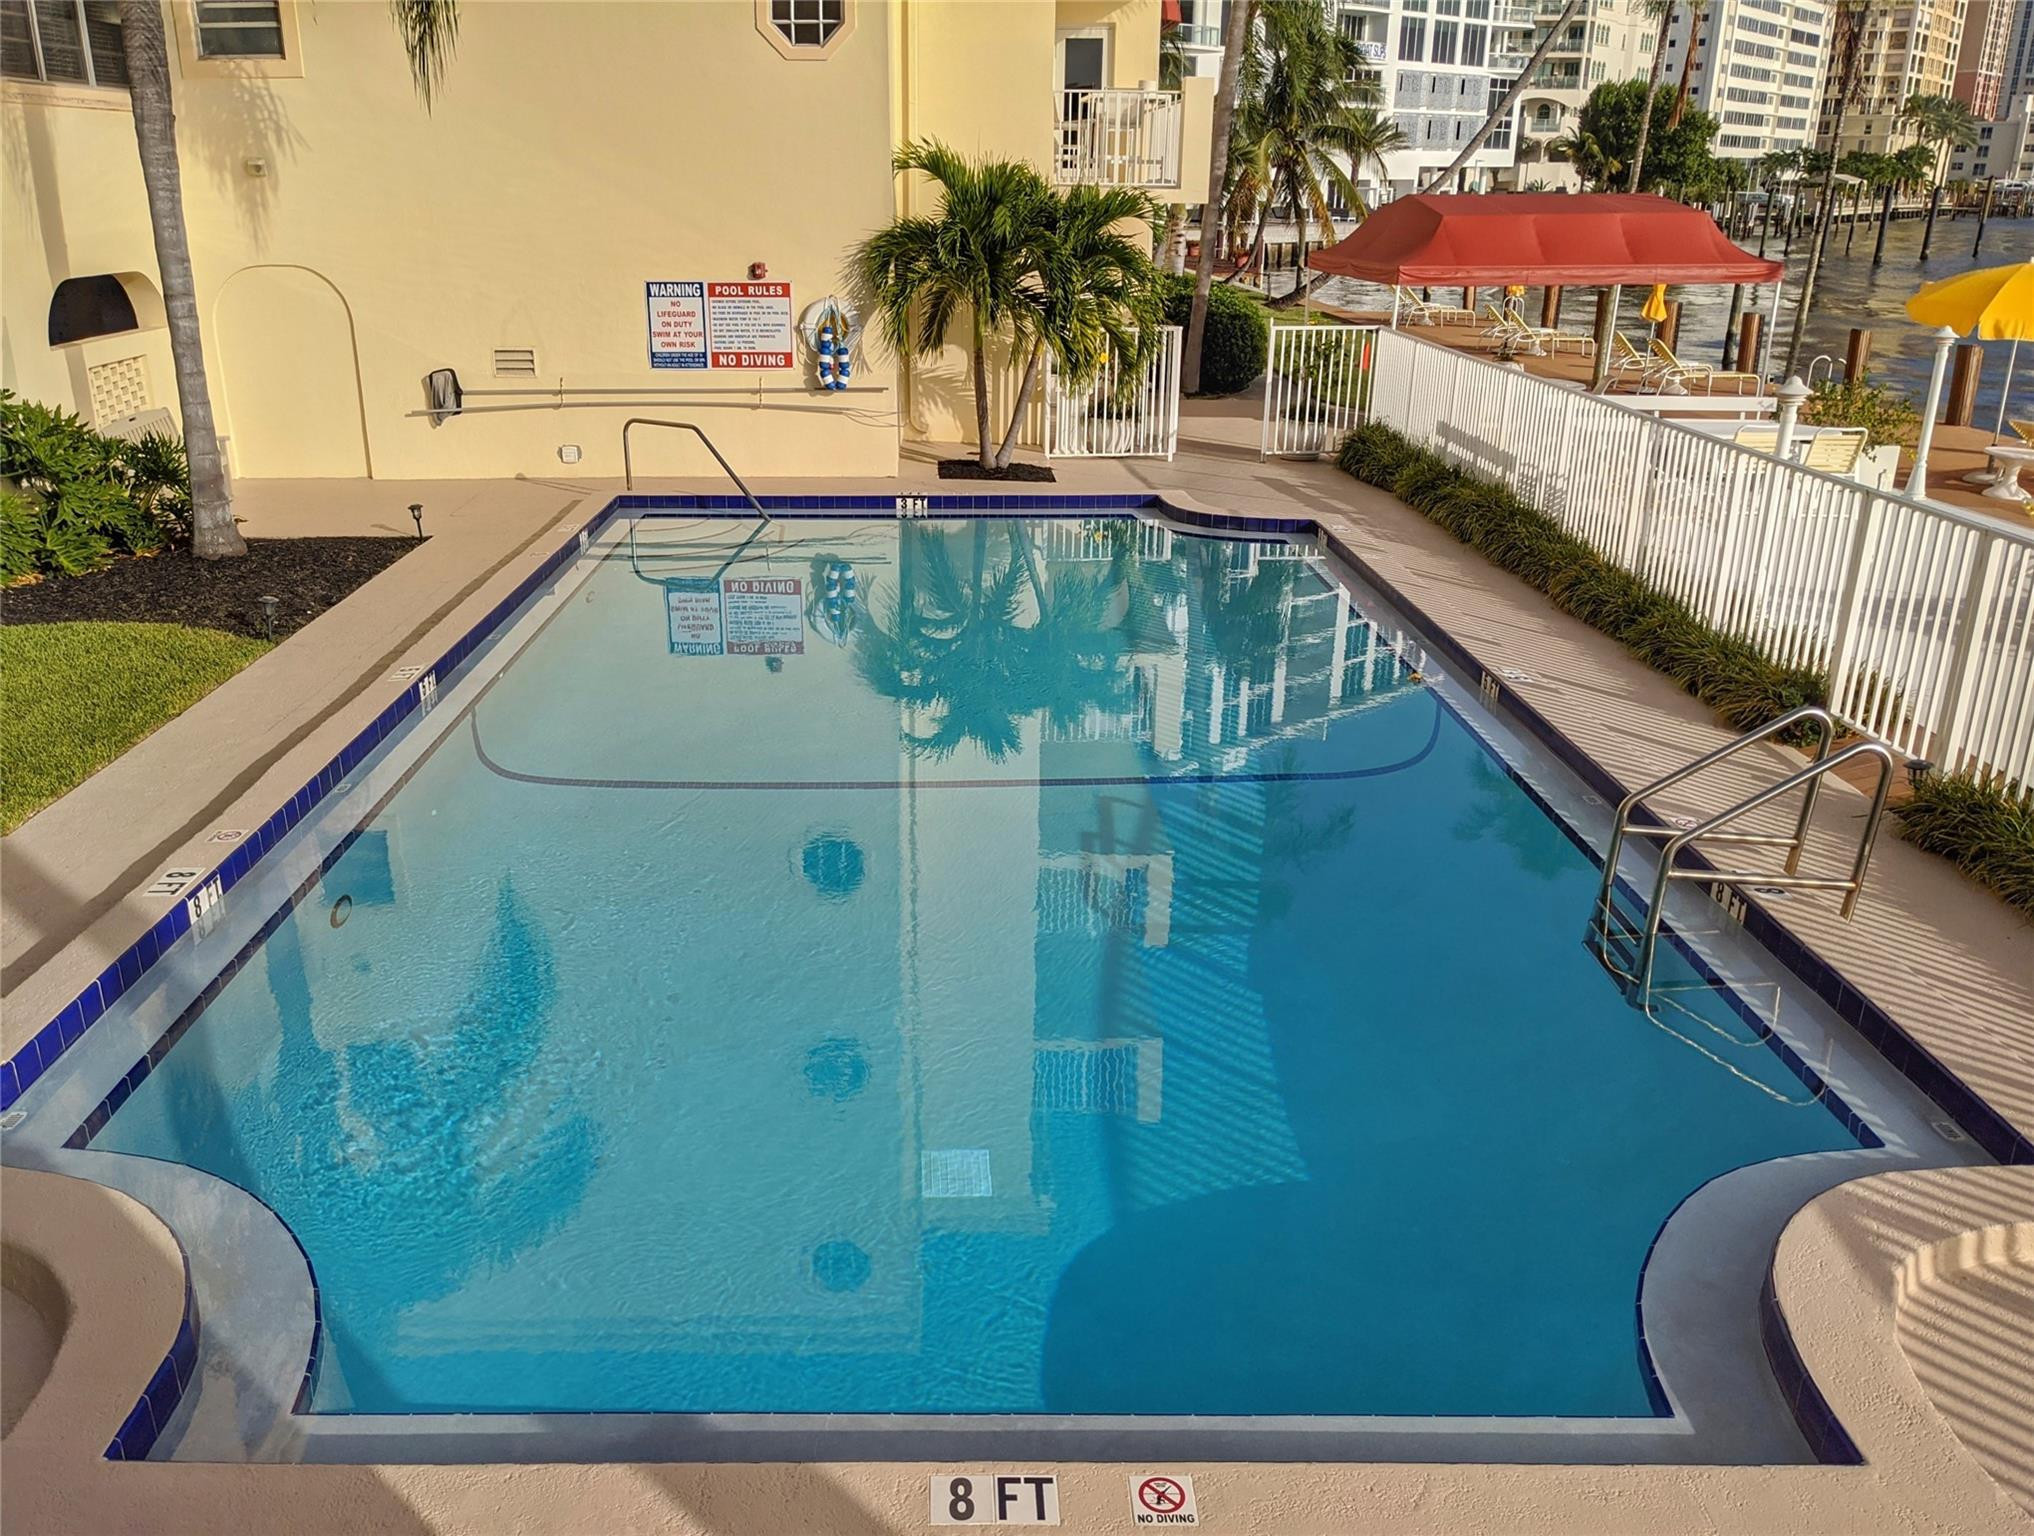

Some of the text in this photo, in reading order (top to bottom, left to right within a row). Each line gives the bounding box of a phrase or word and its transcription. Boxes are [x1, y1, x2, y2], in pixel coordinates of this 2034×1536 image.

[649, 284, 700, 296] WARNING
[715, 286, 783, 295] POOL RULES
[719, 354, 785, 366] NO DIVING
[901, 498, 926, 510] 3 FT
[147, 882, 187, 895] FT
[194, 877, 220, 917] 8 FT
[1716, 882, 1746, 921] 8 FT
[949, 1477, 1054, 1520] 8 FT
[1137, 1514, 1195, 1524] NO DIVING
